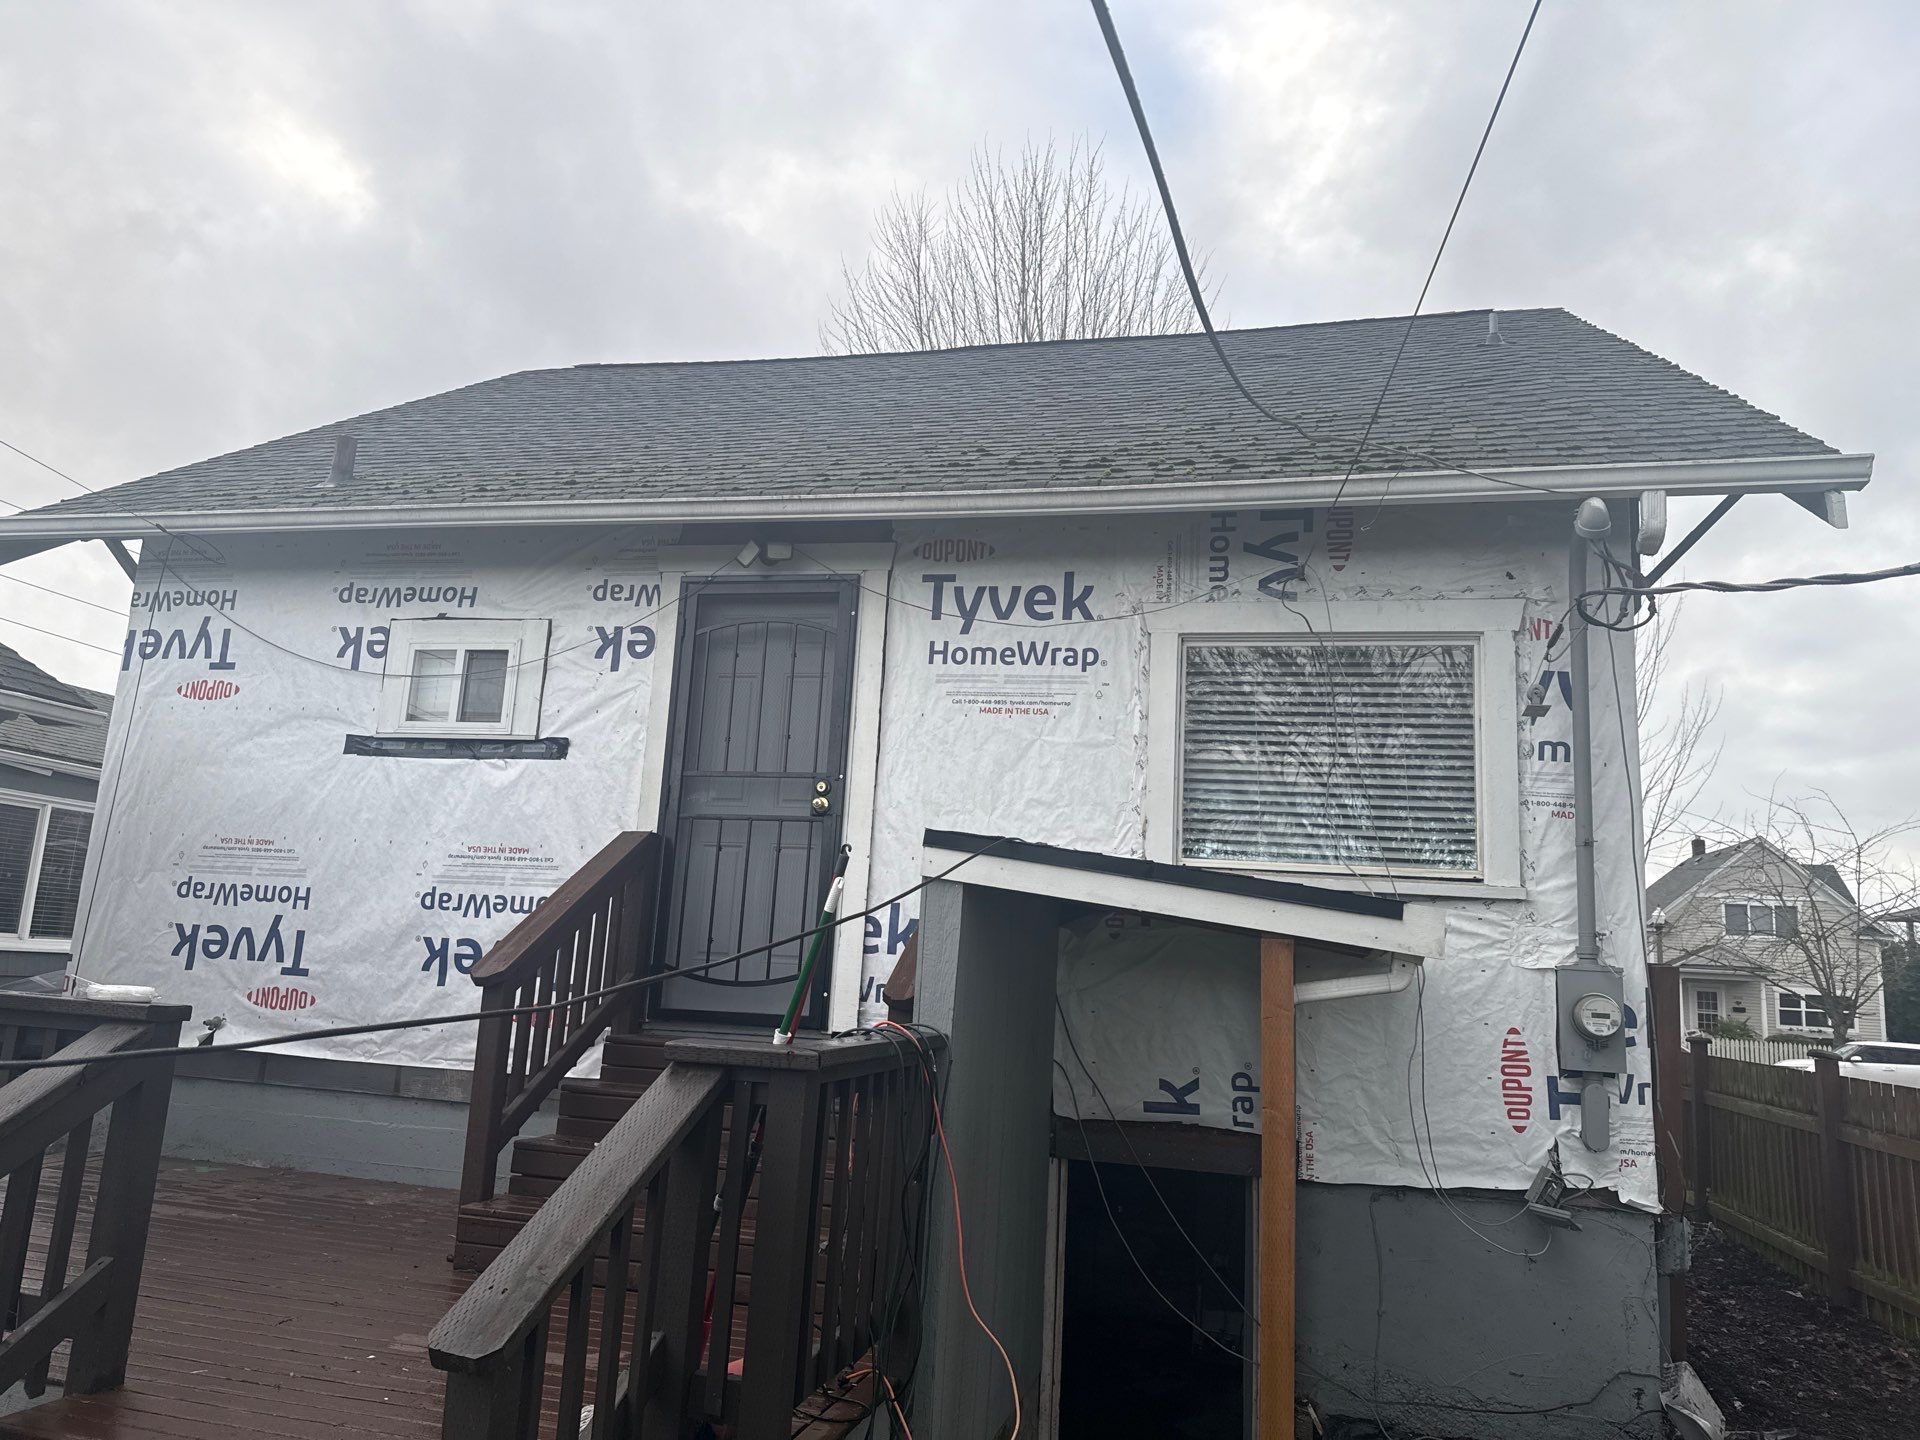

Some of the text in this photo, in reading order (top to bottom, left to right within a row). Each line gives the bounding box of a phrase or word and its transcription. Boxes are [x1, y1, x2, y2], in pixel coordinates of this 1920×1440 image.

[922, 539, 987, 563] DUPONT
[338, 582, 479, 608] HomeWrap
[921, 571, 1096, 635] Tyvek
[928, 640, 1100, 672] HomeWrap
[182, 679, 233, 700] DUPONT
[979, 707, 1049, 716] MADE IN THE USA
[1530, 800, 1575, 809] 1-800-448-9
[220, 837, 232, 845] USA
[234, 837, 246, 845] THE
[255, 838, 275, 846] MADE
[467, 845, 530, 855] MADE IN THE USA
[176, 875, 312, 911] HomeWrap
[170, 914, 310, 977] Tyvek
[253, 986, 308, 1011] DUPONT
[1500, 1038, 1533, 1121] DUPONT
